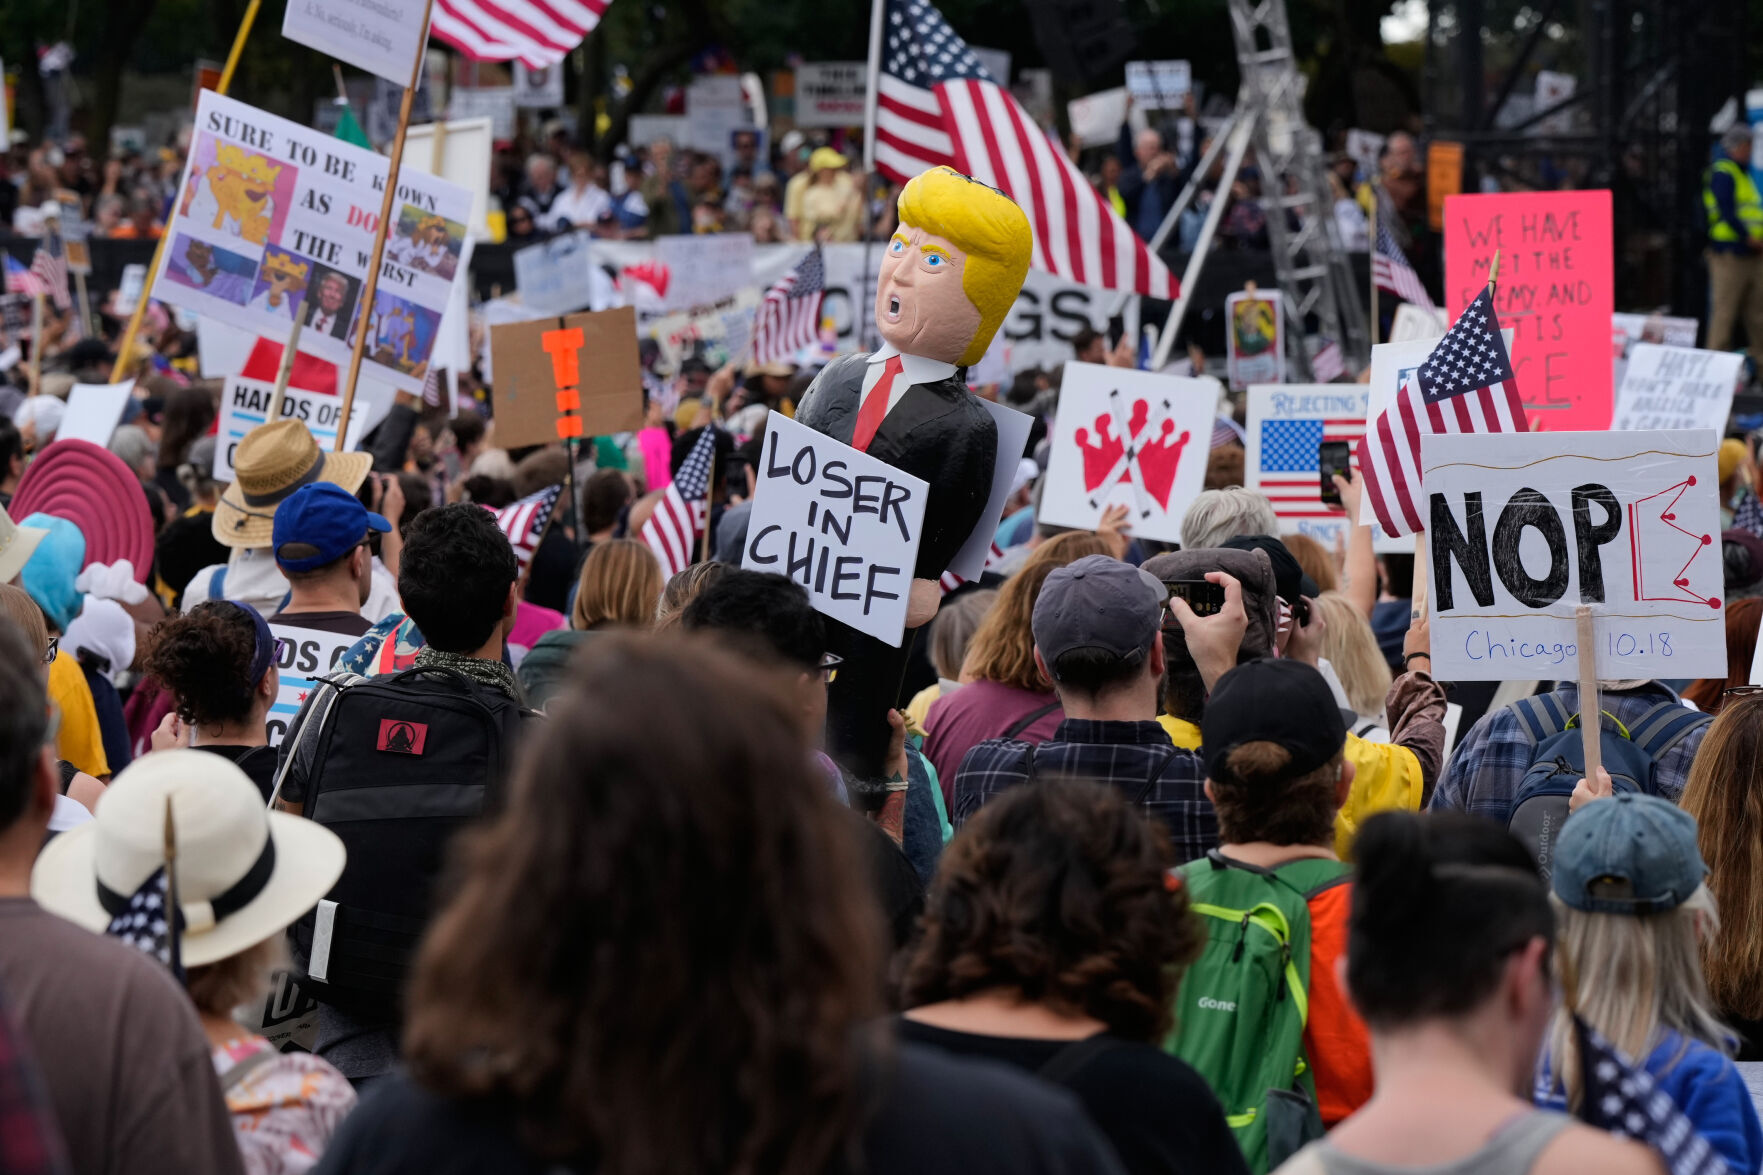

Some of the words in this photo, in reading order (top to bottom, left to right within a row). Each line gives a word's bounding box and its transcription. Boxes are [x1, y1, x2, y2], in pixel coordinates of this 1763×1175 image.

[207, 110, 274, 152] SURE
[287, 138, 317, 168] TO
[324, 148, 358, 183] BE
[372, 173, 439, 212] KOWN
[300, 188, 333, 216] AS
[1463, 214, 1505, 249] WE
[1521, 210, 1582, 243] HAVE
[293, 229, 343, 266] THE
[357, 250, 418, 288] WRST
[1533, 247, 1574, 271] THE
[1547, 280, 1593, 306] AND
[1536, 313, 1564, 342] IS
[1270, 391, 1357, 419] REJECTING
[767, 430, 912, 543] LOSER
[807, 500, 853, 546] IN
[749, 524, 901, 616] CHIEF
[1464, 629, 1578, 665] Chicago
[1607, 631, 1674, 658] 10.18
[1537, 810, 1551, 865] Outdoor
